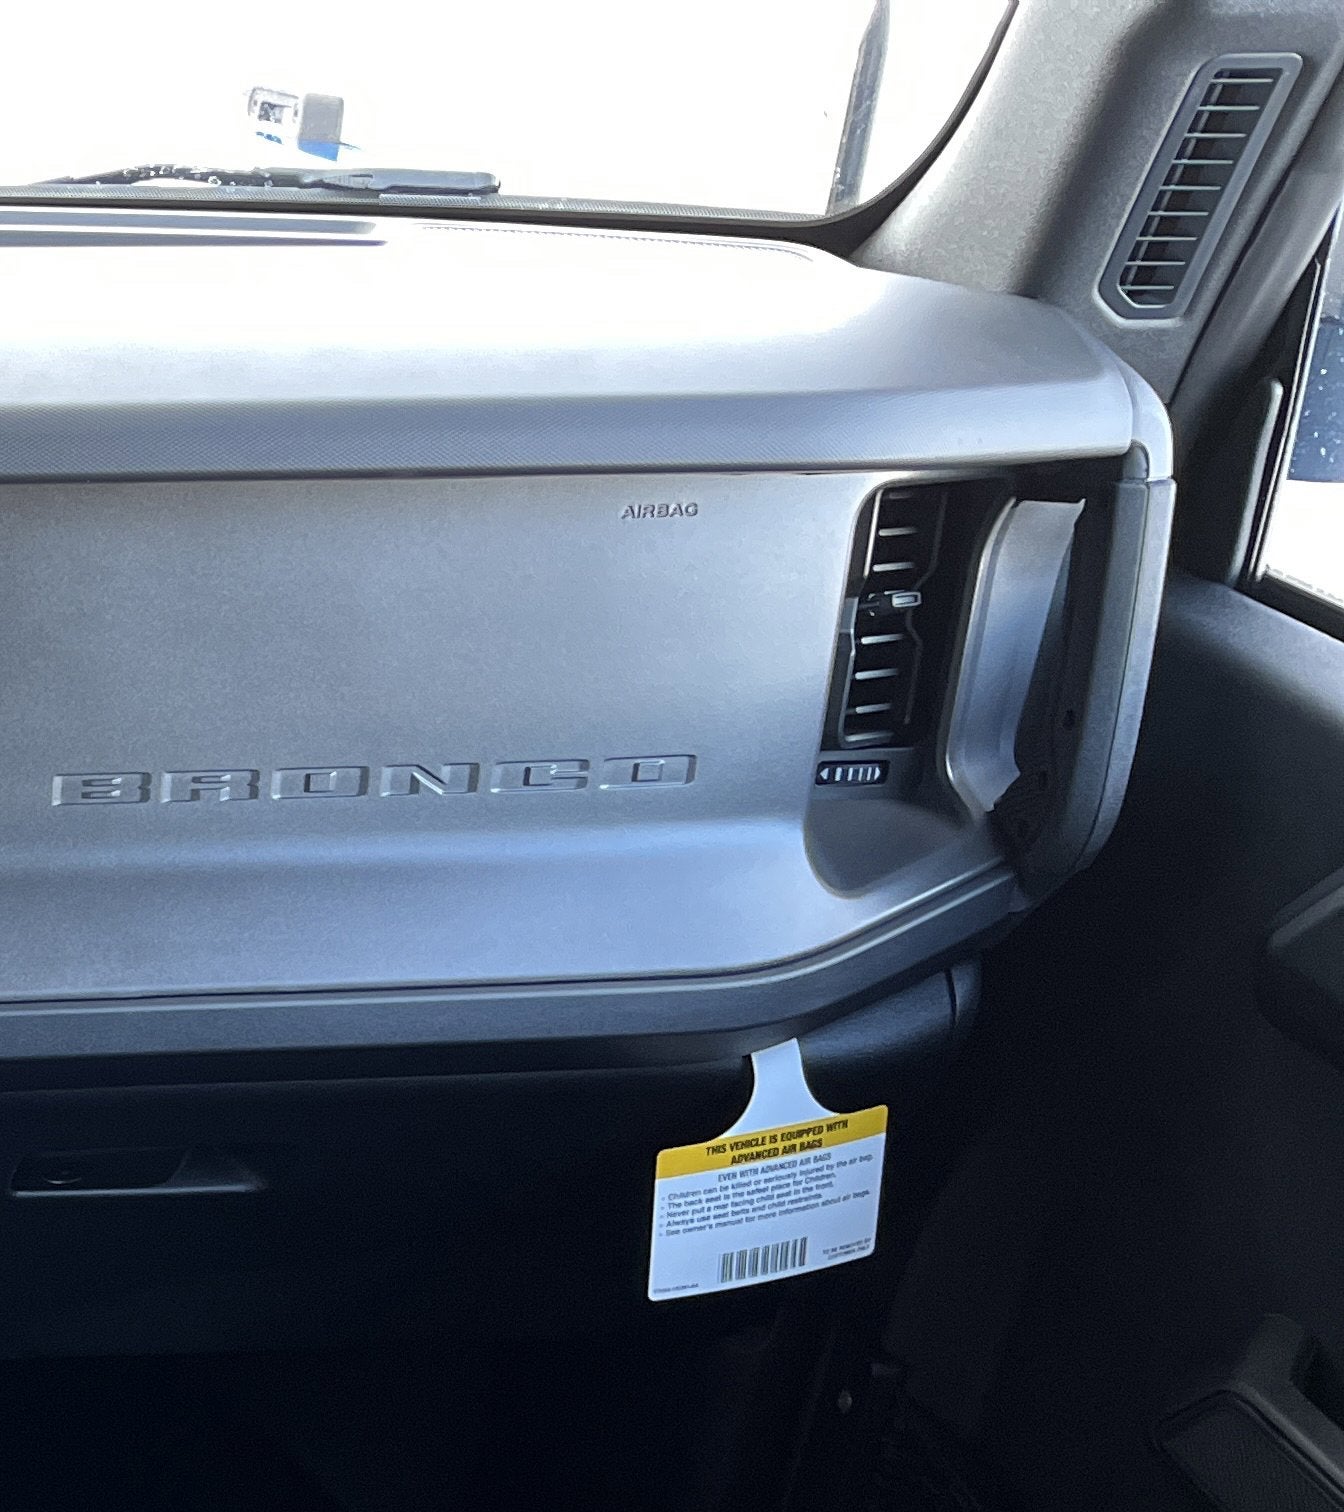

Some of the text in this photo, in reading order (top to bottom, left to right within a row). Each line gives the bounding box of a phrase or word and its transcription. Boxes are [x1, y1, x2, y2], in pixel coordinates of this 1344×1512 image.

[621, 503, 699, 520] AIRBAG
[52, 754, 697, 806] BRONCO
[705, 1118, 848, 1157] THIS VEHICLE IS EQUIPPED WITH
[730, 1137, 823, 1165] ADVANCED AIR BAGS
[702, 1186, 717, 1195] can
[719, 1183, 729, 1192] be
[836, 1159, 847, 1168] the
[717, 1151, 831, 1182] EVEN WITH ADVANCED AIR BAGS
[665, 1215, 694, 1229] Always
[696, 1214, 710, 1223] use
[767, 1199, 785, 1209] child
[666, 1207, 689, 1219] Never
[691, 1205, 705, 1216] put
[667, 1200, 682, 1210] The
[683, 1196, 702, 1207] back
[757, 1210, 777, 1220] more
[777, 1201, 819, 1216] information
